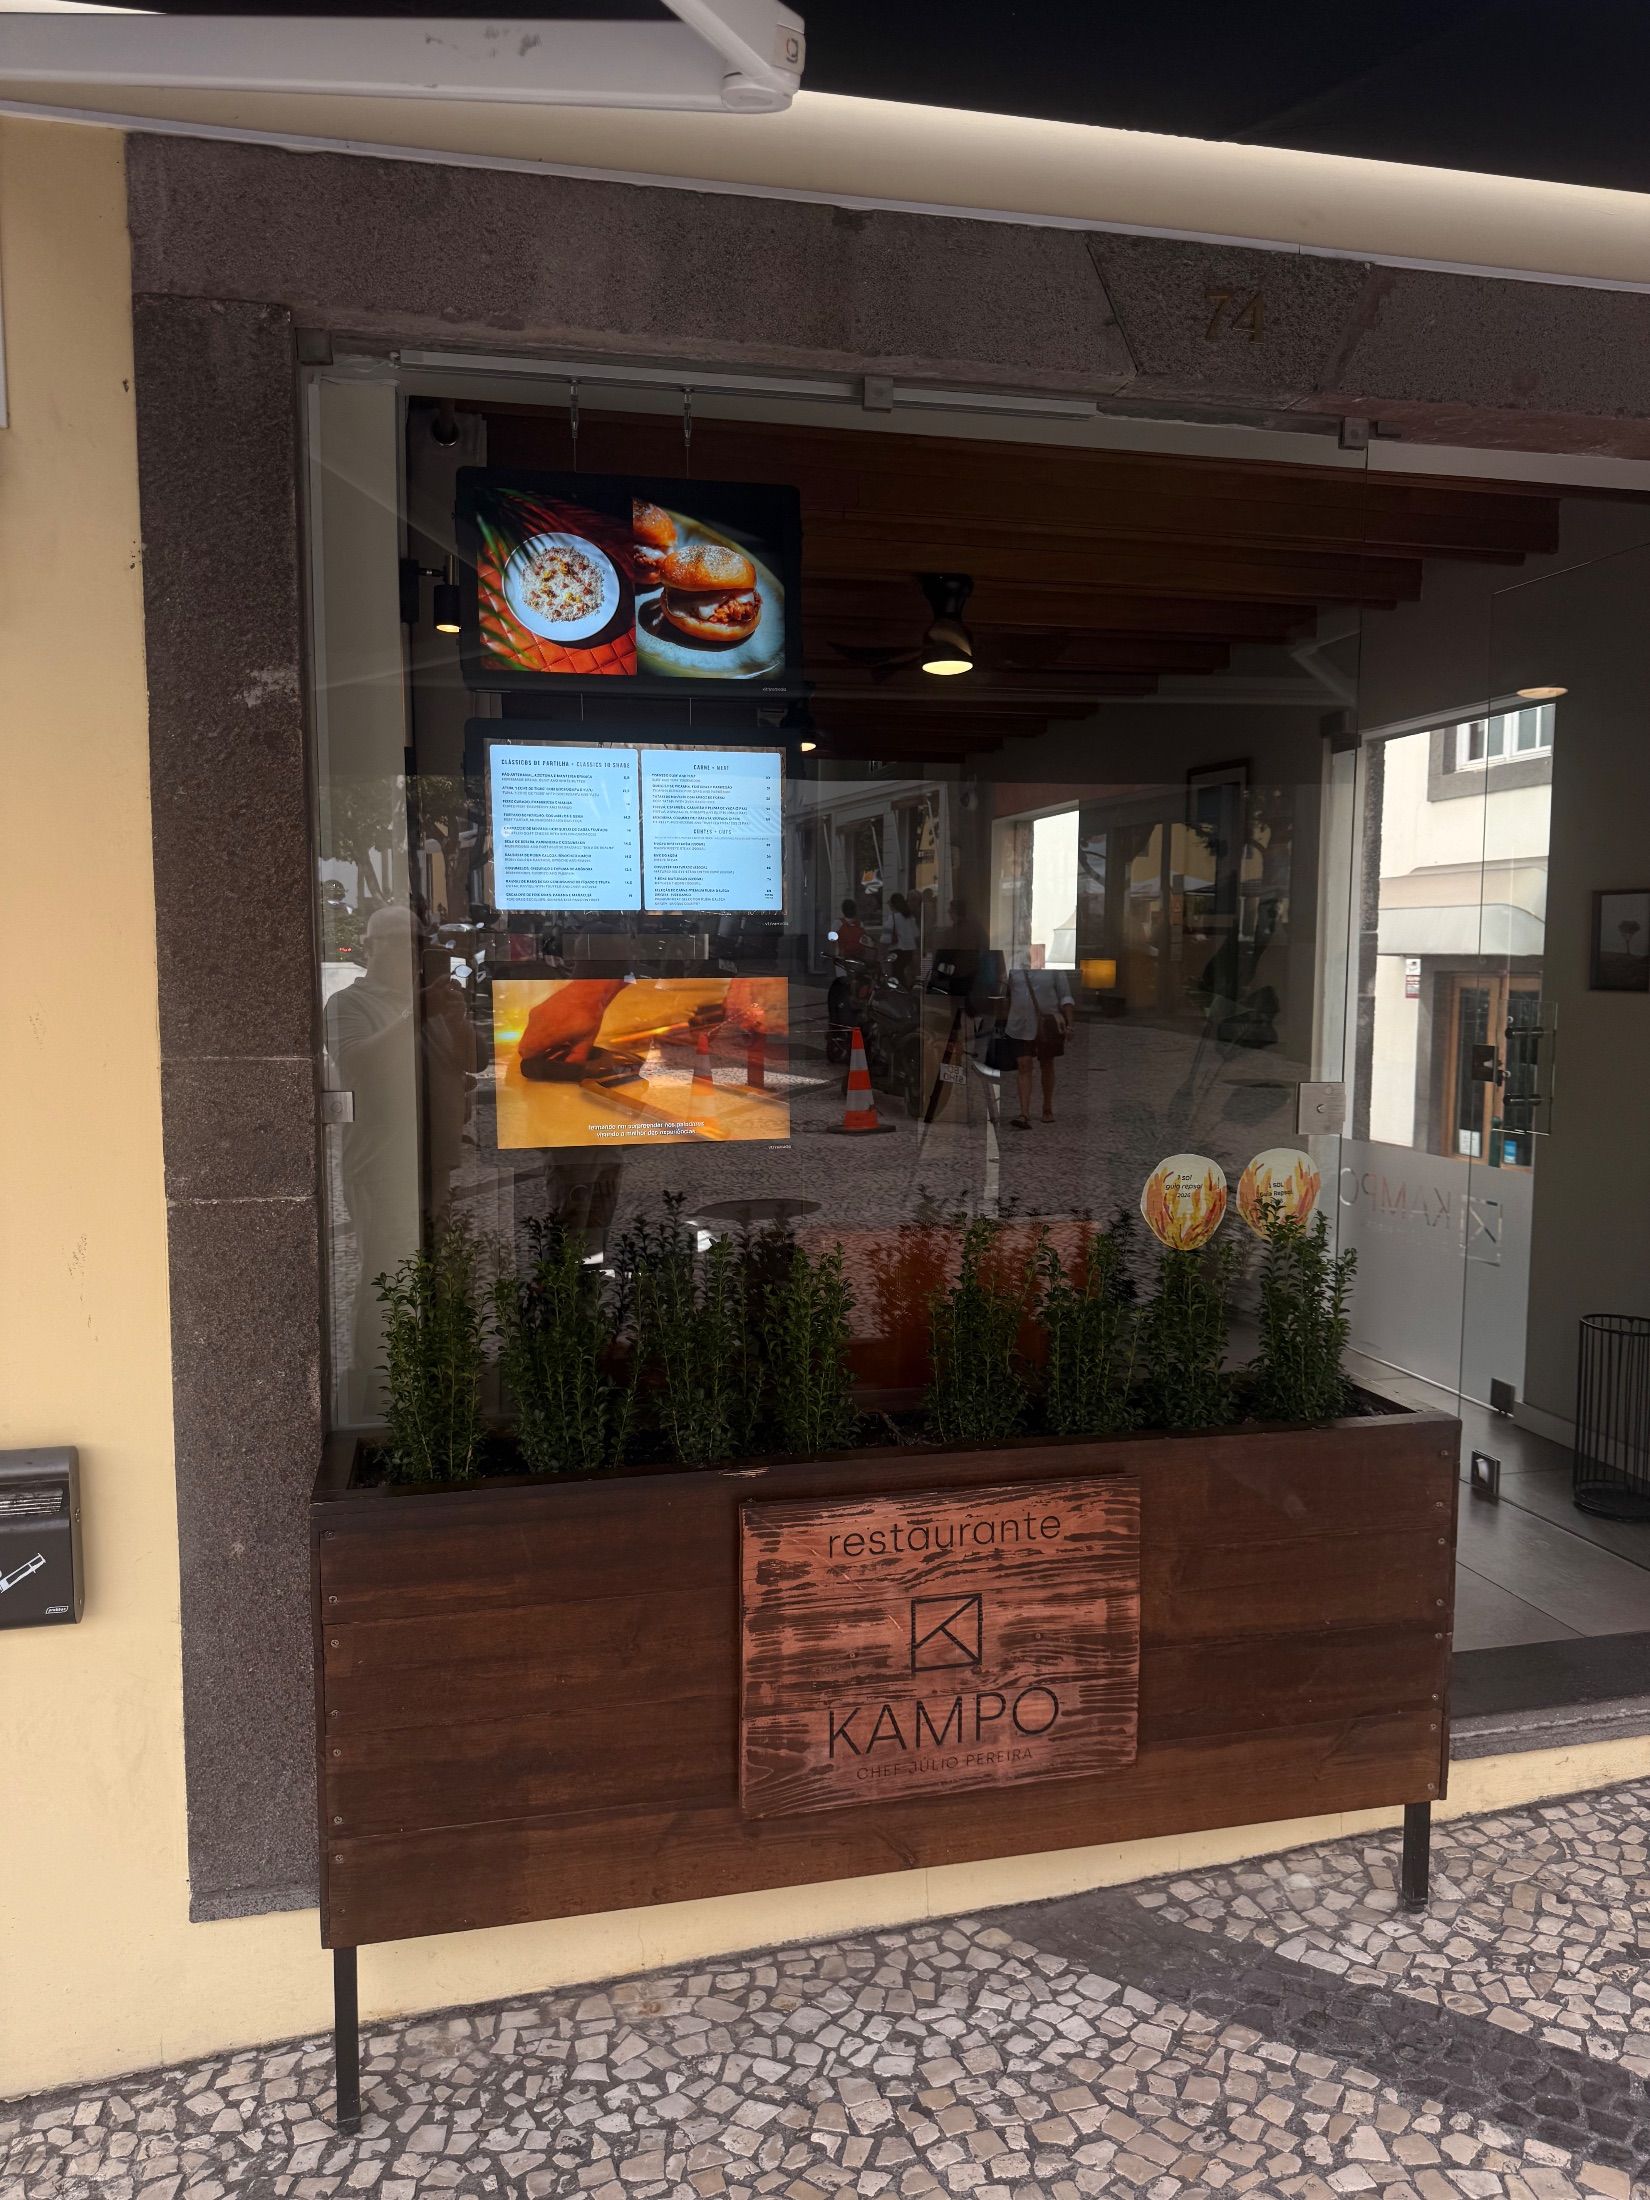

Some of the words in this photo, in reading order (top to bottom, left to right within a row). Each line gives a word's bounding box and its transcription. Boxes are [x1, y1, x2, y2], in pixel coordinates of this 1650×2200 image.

[1202, 289, 1266, 346] 74
[828, 1511, 1061, 1558] restaurante
[828, 1686, 1060, 1759] KAMPO
[856, 1763, 900, 1780] CHEF
[908, 1754, 960, 1774] JÚLIO
[965, 1747, 1034, 1766] PEREIRA
